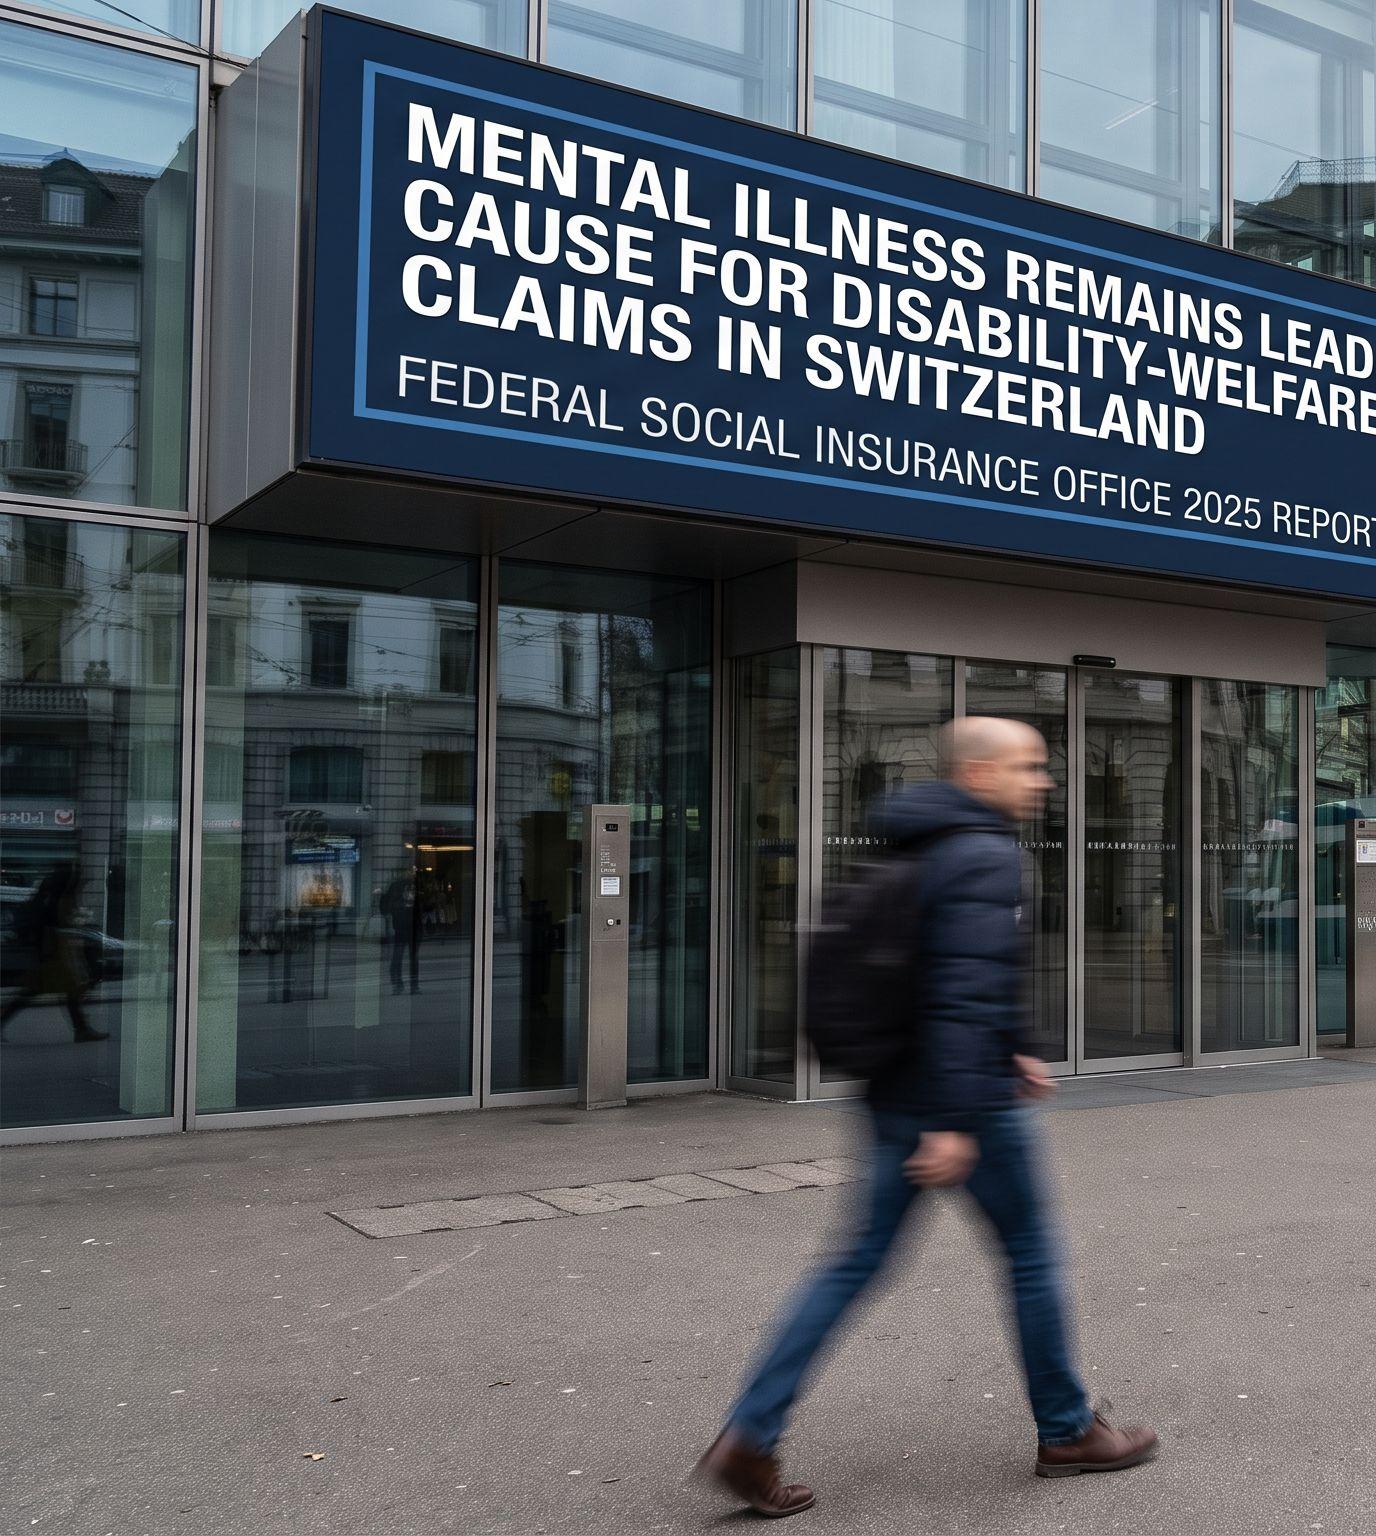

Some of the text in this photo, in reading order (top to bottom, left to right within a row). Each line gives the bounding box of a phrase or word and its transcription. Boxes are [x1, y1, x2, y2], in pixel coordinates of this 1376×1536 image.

[404, 179, 654, 287] CAUSE
[680, 237, 809, 319] FOR
[407, 102, 711, 230] MENTAL
[735, 182, 986, 291] ILLNESS
[1006, 249, 1244, 350] REMAINS
[398, 354, 624, 432] FEDERAL
[640, 396, 800, 459] SOCIAL
[816, 425, 1040, 496] INSURANCE
[1053, 465, 1172, 517] OFFICE
[1183, 487, 1262, 530] 2025
[402, 254, 1205, 455] CLAIMS IN SWITZERLAND
